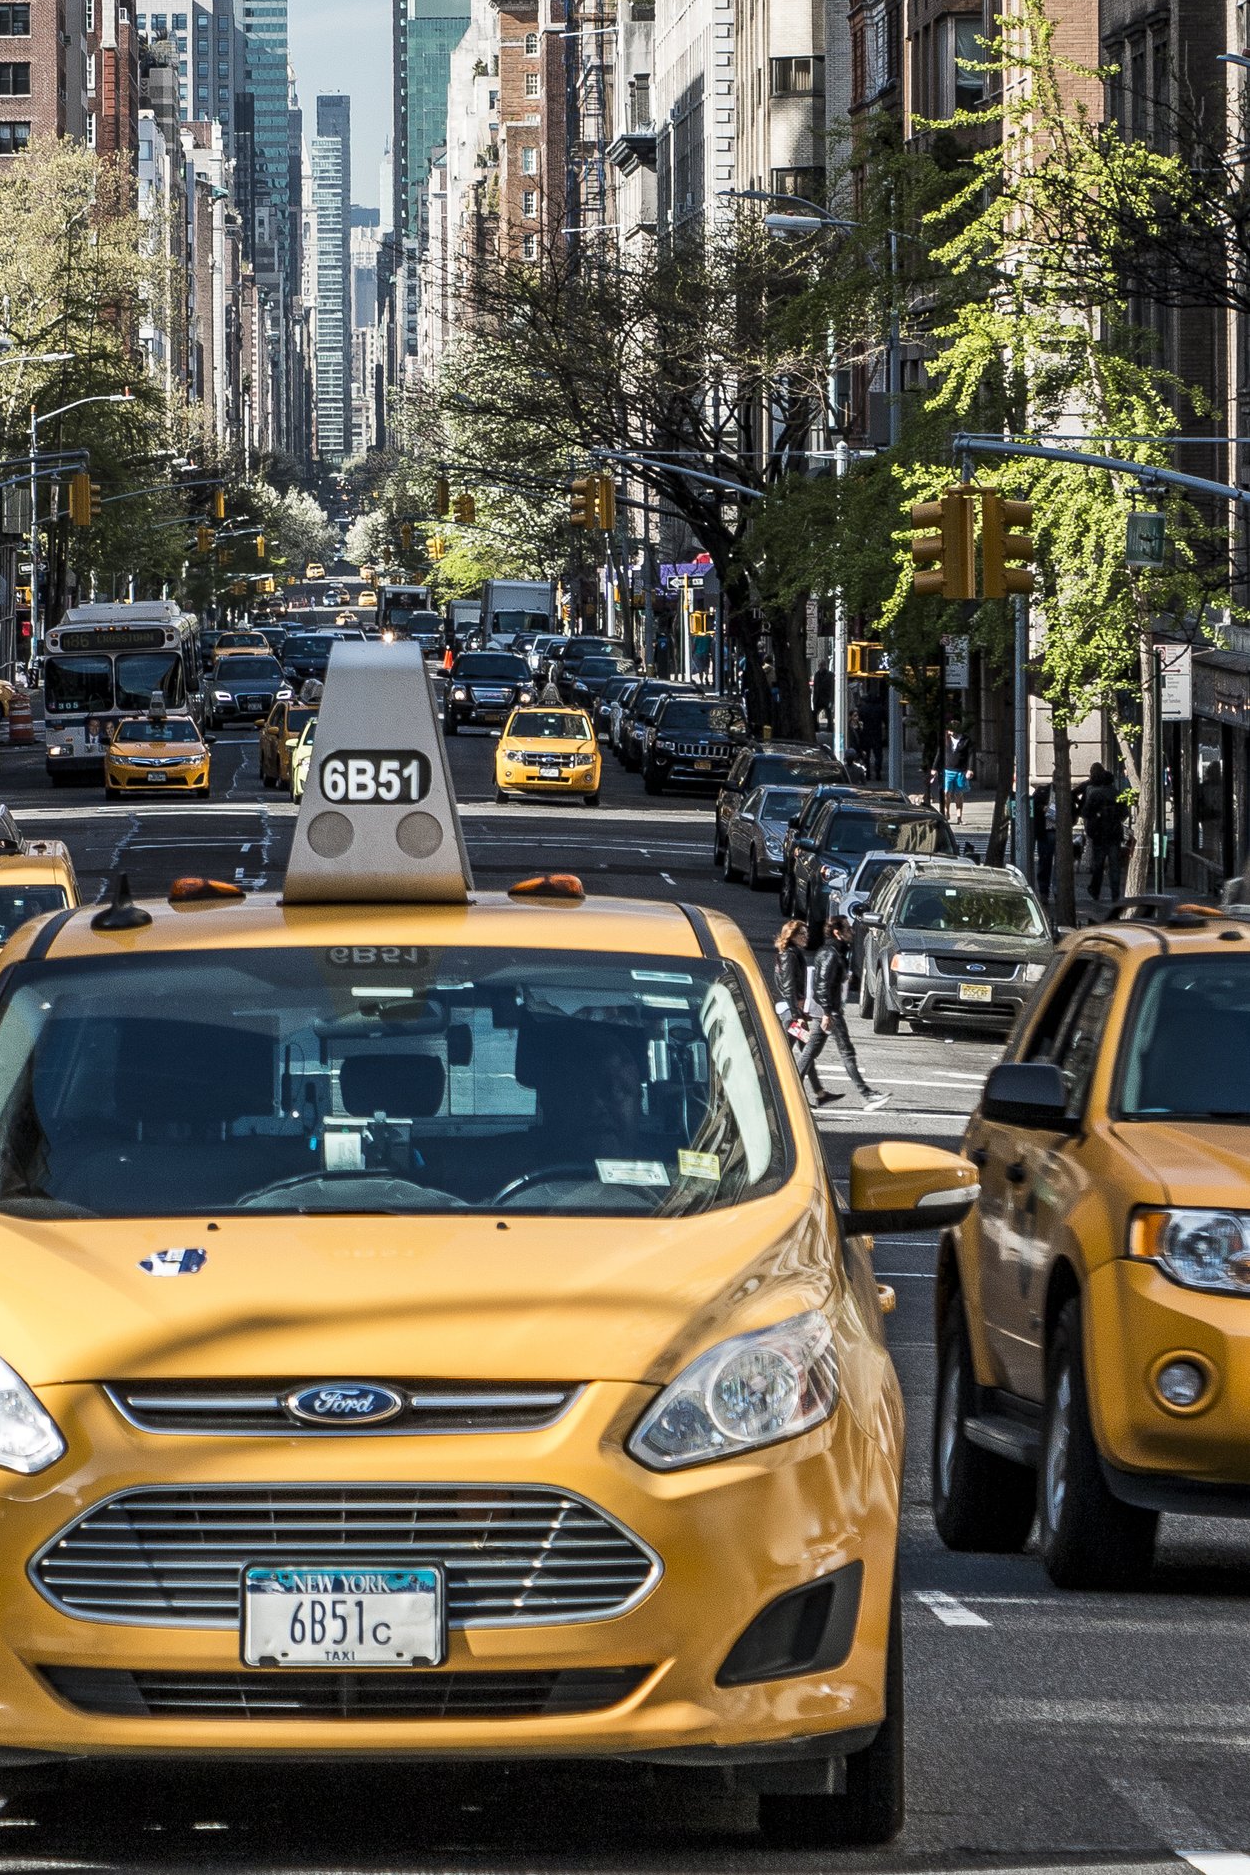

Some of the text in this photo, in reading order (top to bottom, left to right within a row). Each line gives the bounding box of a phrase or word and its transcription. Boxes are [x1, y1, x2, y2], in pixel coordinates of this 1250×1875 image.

[323, 758, 420, 801] 6B51
[313, 1389, 376, 1414] Ford
[292, 1574, 392, 1594] NEW YORK
[325, 1650, 356, 1662] TAXI
